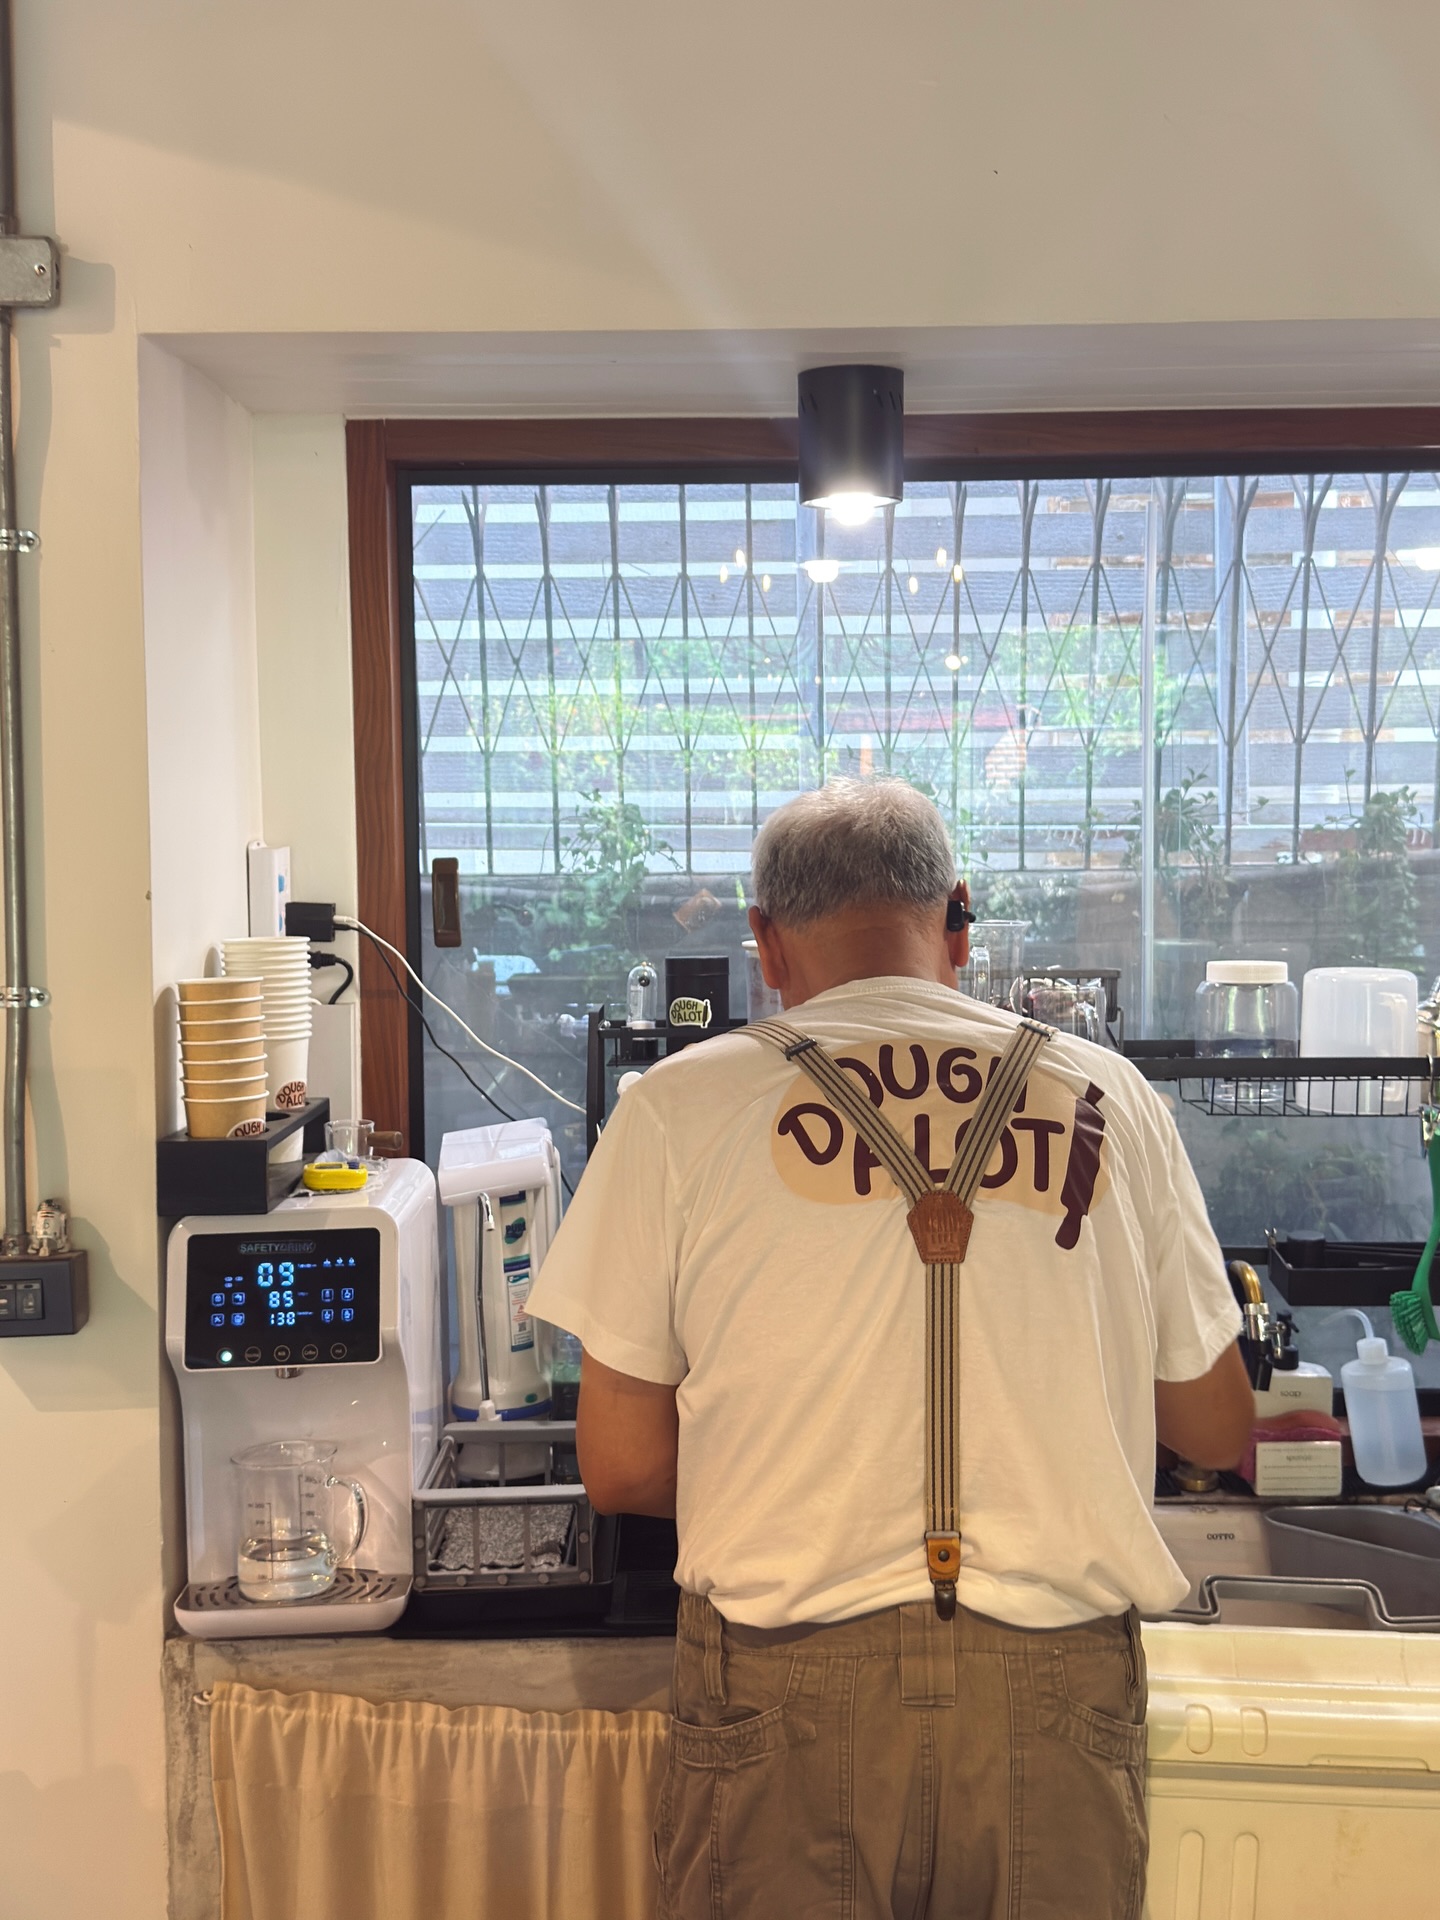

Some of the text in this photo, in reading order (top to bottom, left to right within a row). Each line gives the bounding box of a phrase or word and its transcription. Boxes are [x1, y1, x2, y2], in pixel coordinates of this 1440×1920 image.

[671, 1000, 698, 1019] DOUGH
[677, 1010, 702, 1023] ALOT
[234, 1121, 261, 1137] OUGH
[257, 1261, 294, 1287] 09
[268, 1289, 294, 1309] 85
[1206, 1533, 1235, 1541] COTTO
